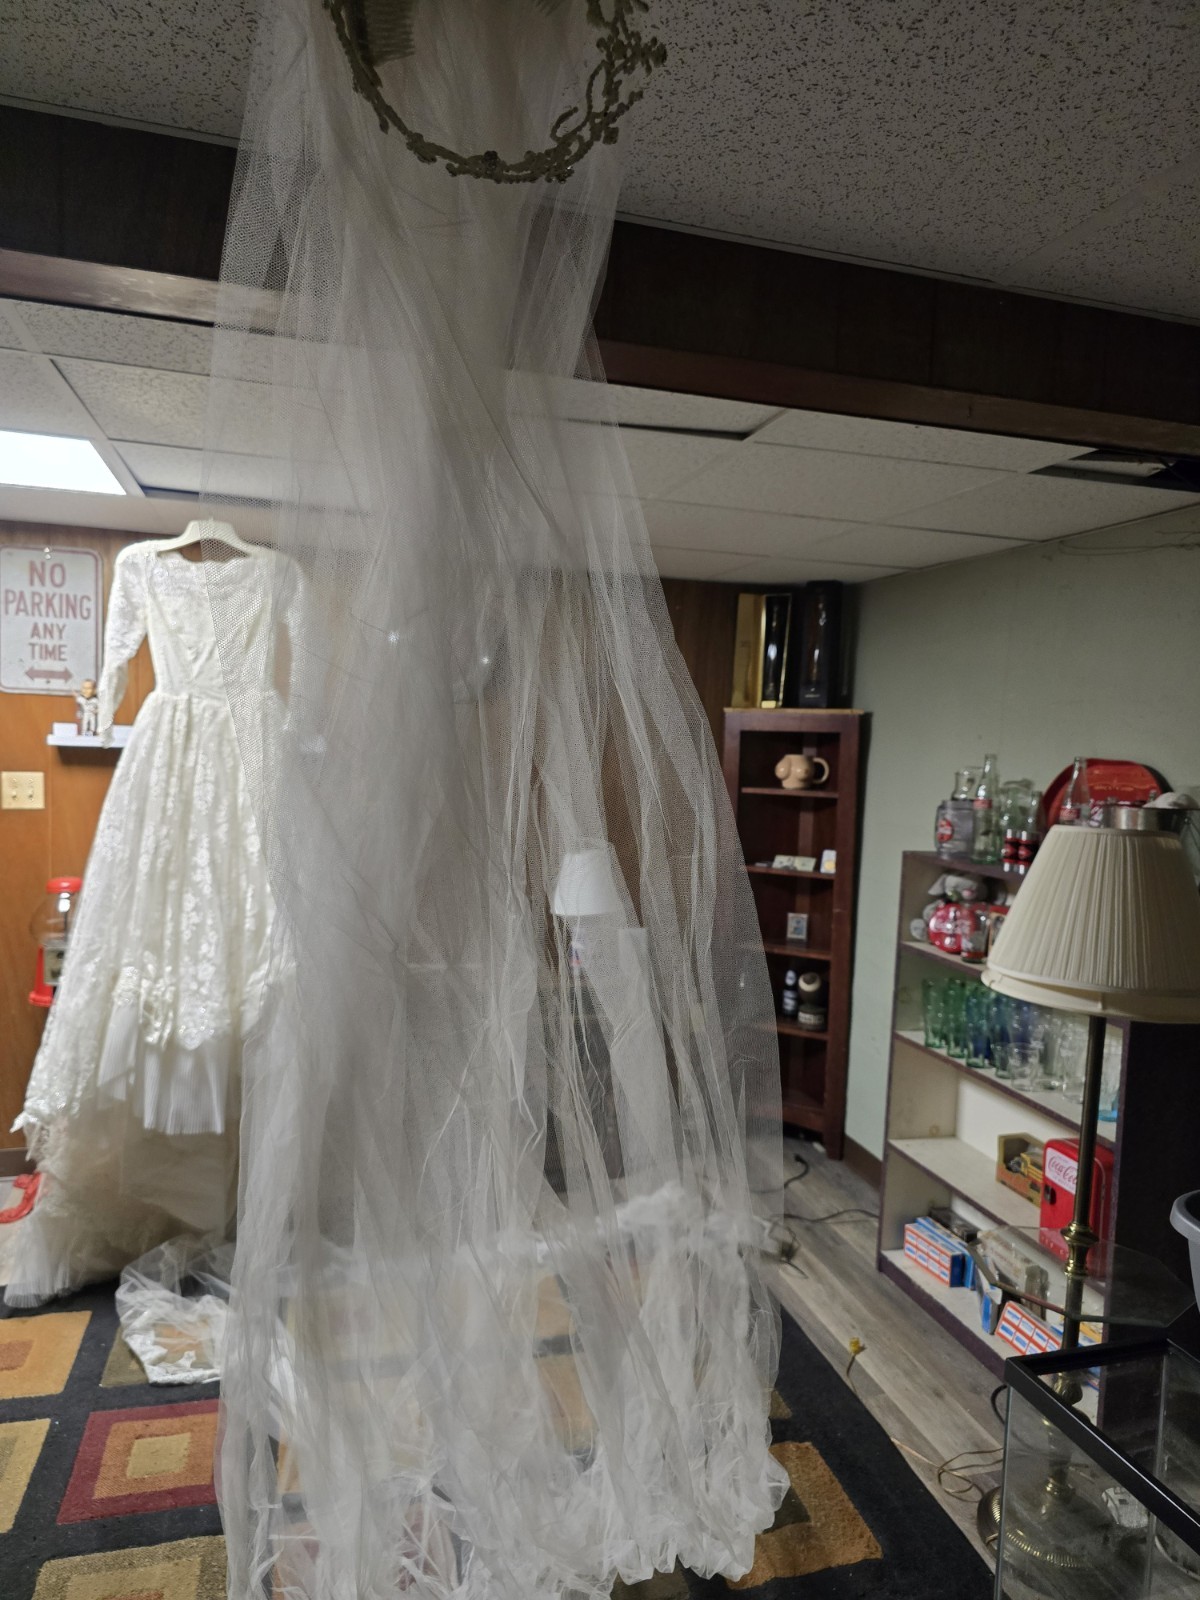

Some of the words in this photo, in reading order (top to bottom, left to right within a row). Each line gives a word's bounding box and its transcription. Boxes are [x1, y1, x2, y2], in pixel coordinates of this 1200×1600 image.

[29, 560, 67, 588] NO
[4, 589, 92, 620] PARKING
[30, 622, 67, 640] ANY
[28, 643, 68, 662] TIME
